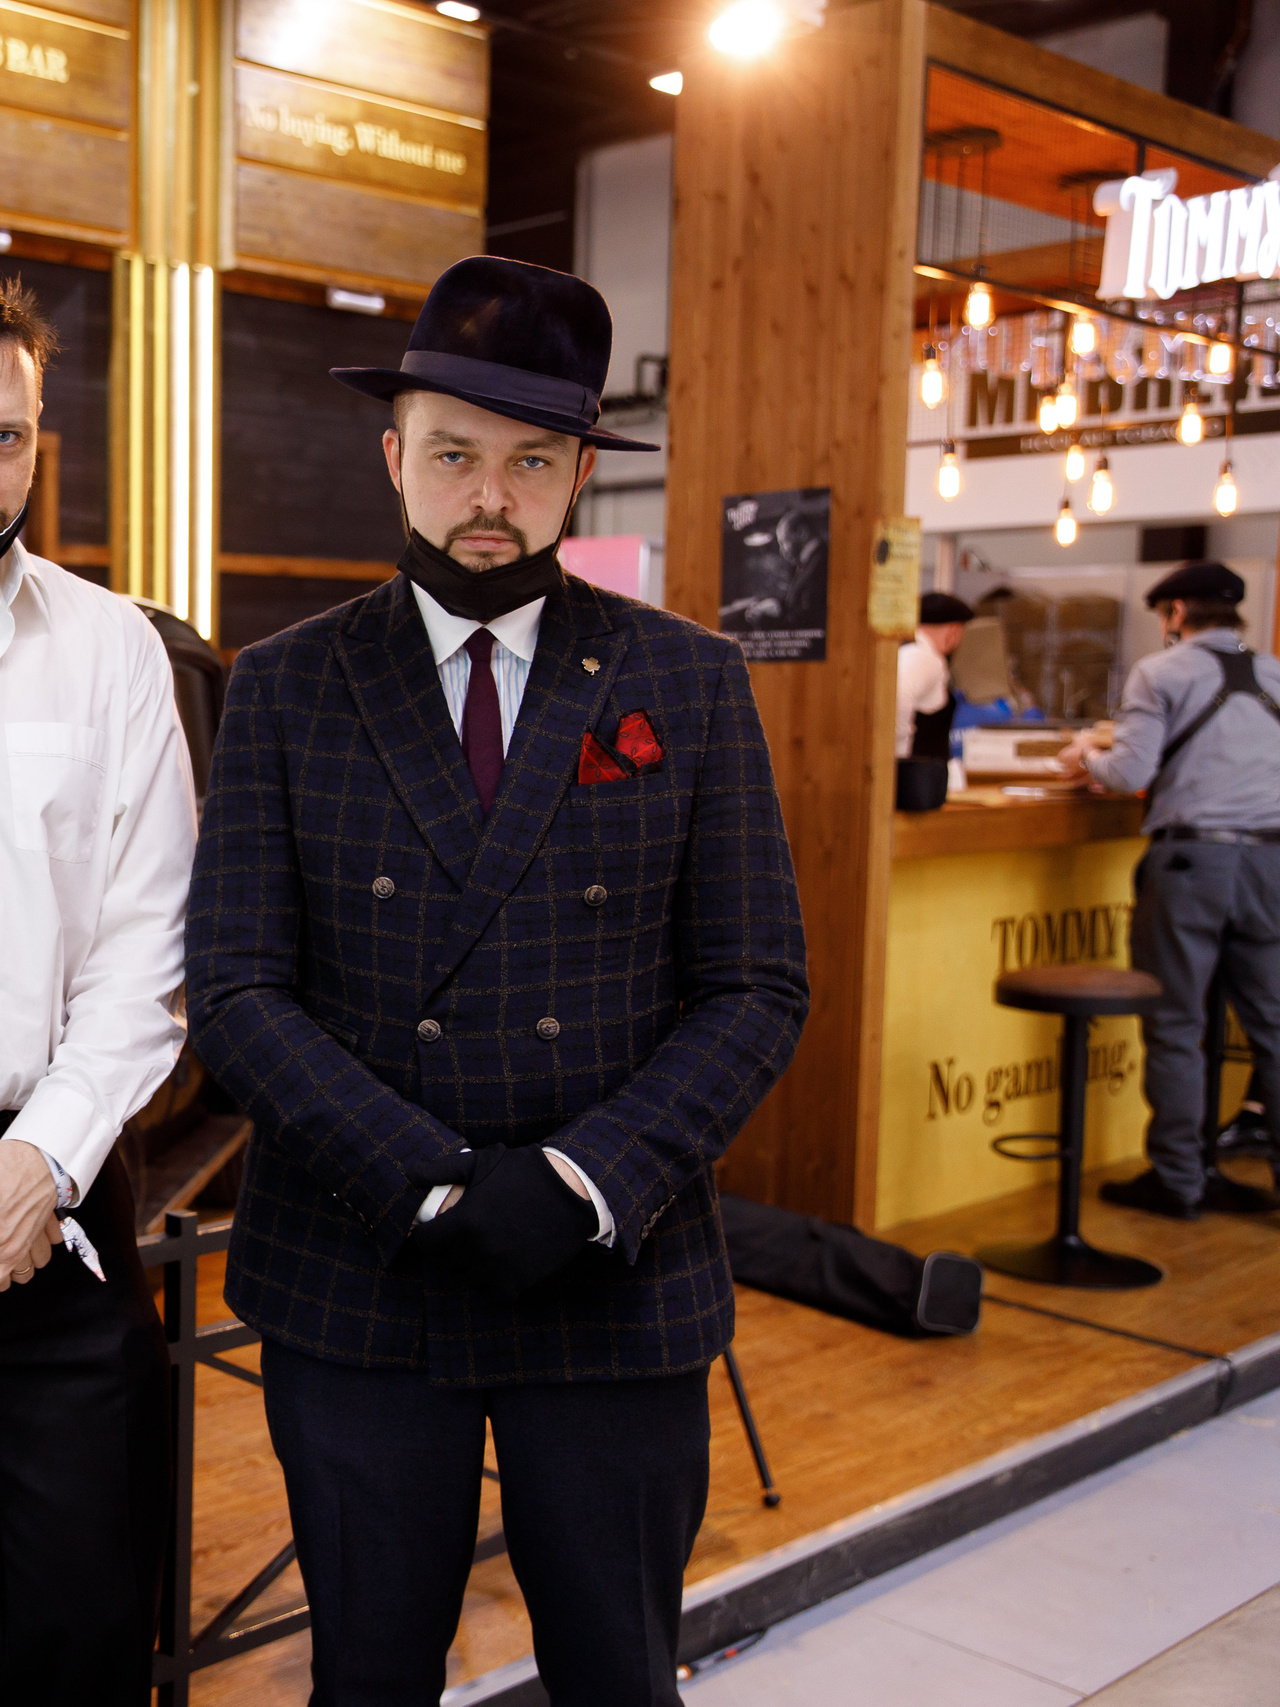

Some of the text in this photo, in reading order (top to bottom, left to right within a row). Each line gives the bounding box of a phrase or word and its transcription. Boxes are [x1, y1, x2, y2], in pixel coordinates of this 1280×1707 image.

[5, 36, 70, 84] BAR
[244, 101, 278, 133] No
[353, 121, 434, 169] Without
[433, 149, 467, 176] me
[926, 1057, 976, 1121] No
